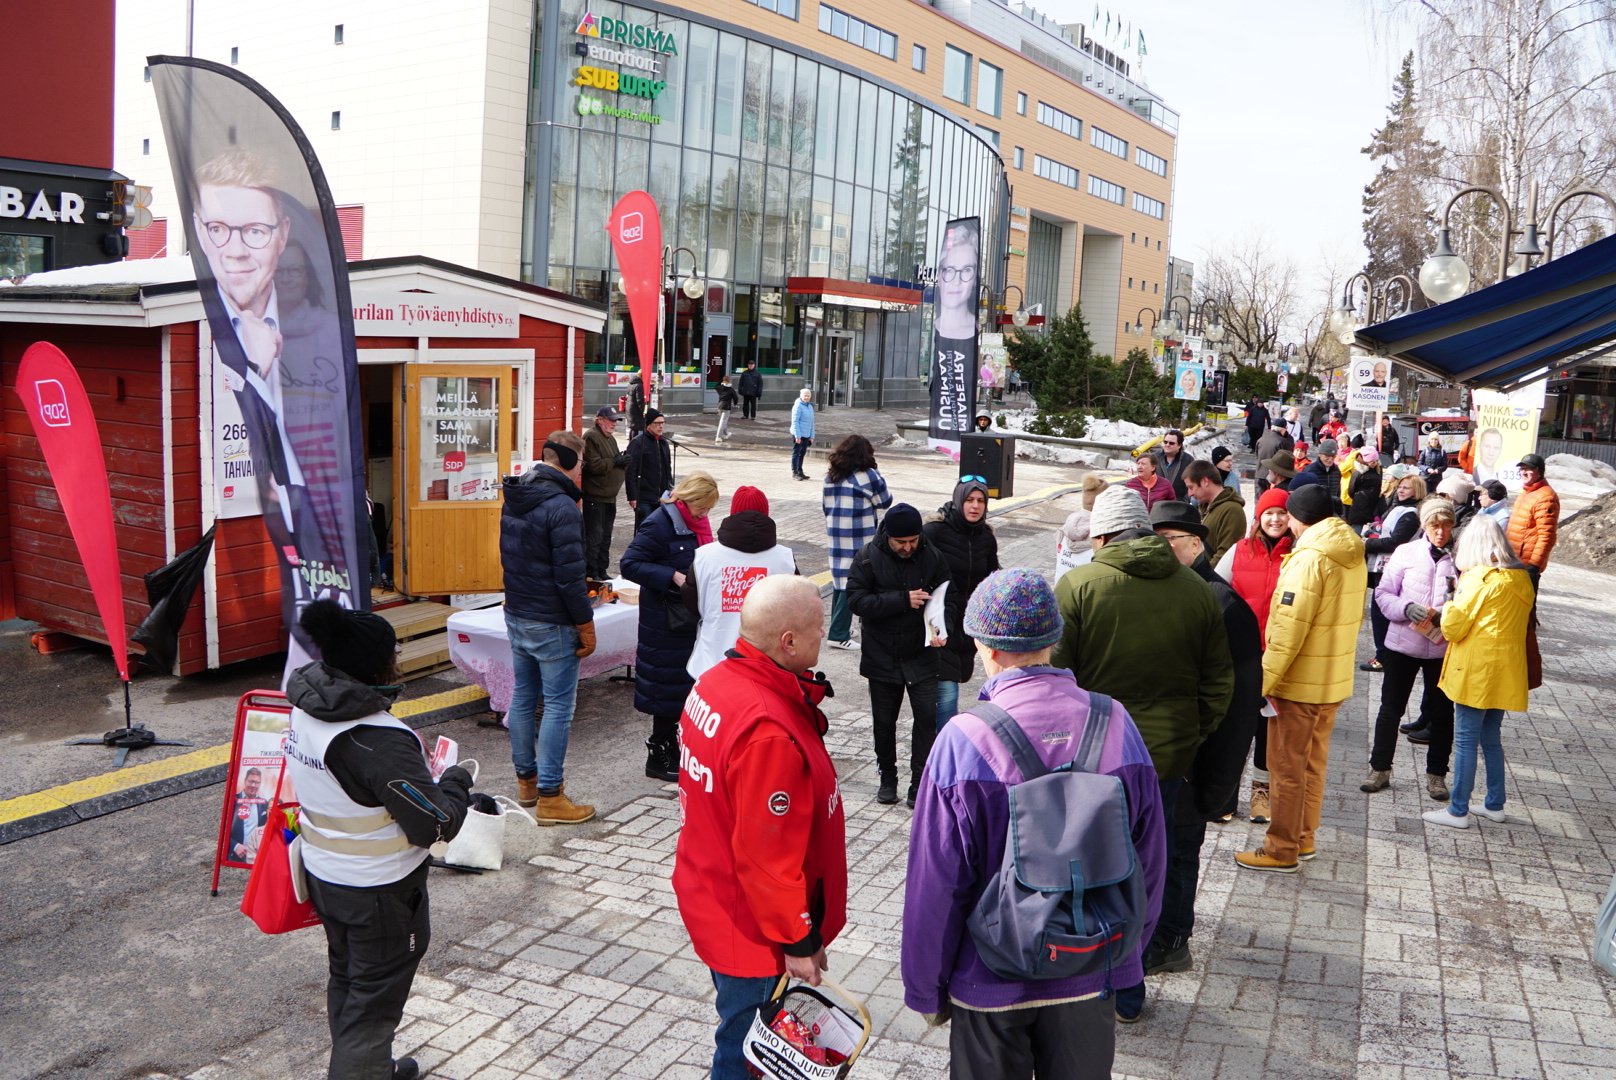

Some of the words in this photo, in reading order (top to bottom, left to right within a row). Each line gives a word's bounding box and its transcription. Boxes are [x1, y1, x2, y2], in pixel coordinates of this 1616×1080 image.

[600, 16, 678, 56] PRISMA
[589, 45, 656, 71] emotion
[574, 65, 667, 100] SUBWAY
[604, 104, 635, 120] Musti
[0, 185, 84, 224] BAR
[399, 304, 503, 328] Työväenyhdistys
[436, 391, 478, 404] MEILLÄ
[1352, 393, 1386, 401] KASONEN
[421, 406, 461, 418] TAITAA
[462, 407, 491, 418] OLLA
[1483, 404, 1511, 417] MIKA
[440, 420, 472, 431] SAMA
[1482, 415, 1530, 431] NIIKKO
[222, 424, 248, 441] 266
[432, 434, 479, 444] SUUNTA
[223, 442, 248, 459] Säde
[445, 461, 463, 470] SDP
[238, 808, 250, 816] 254
[781, 1044, 837, 1078] KILJUNEN
